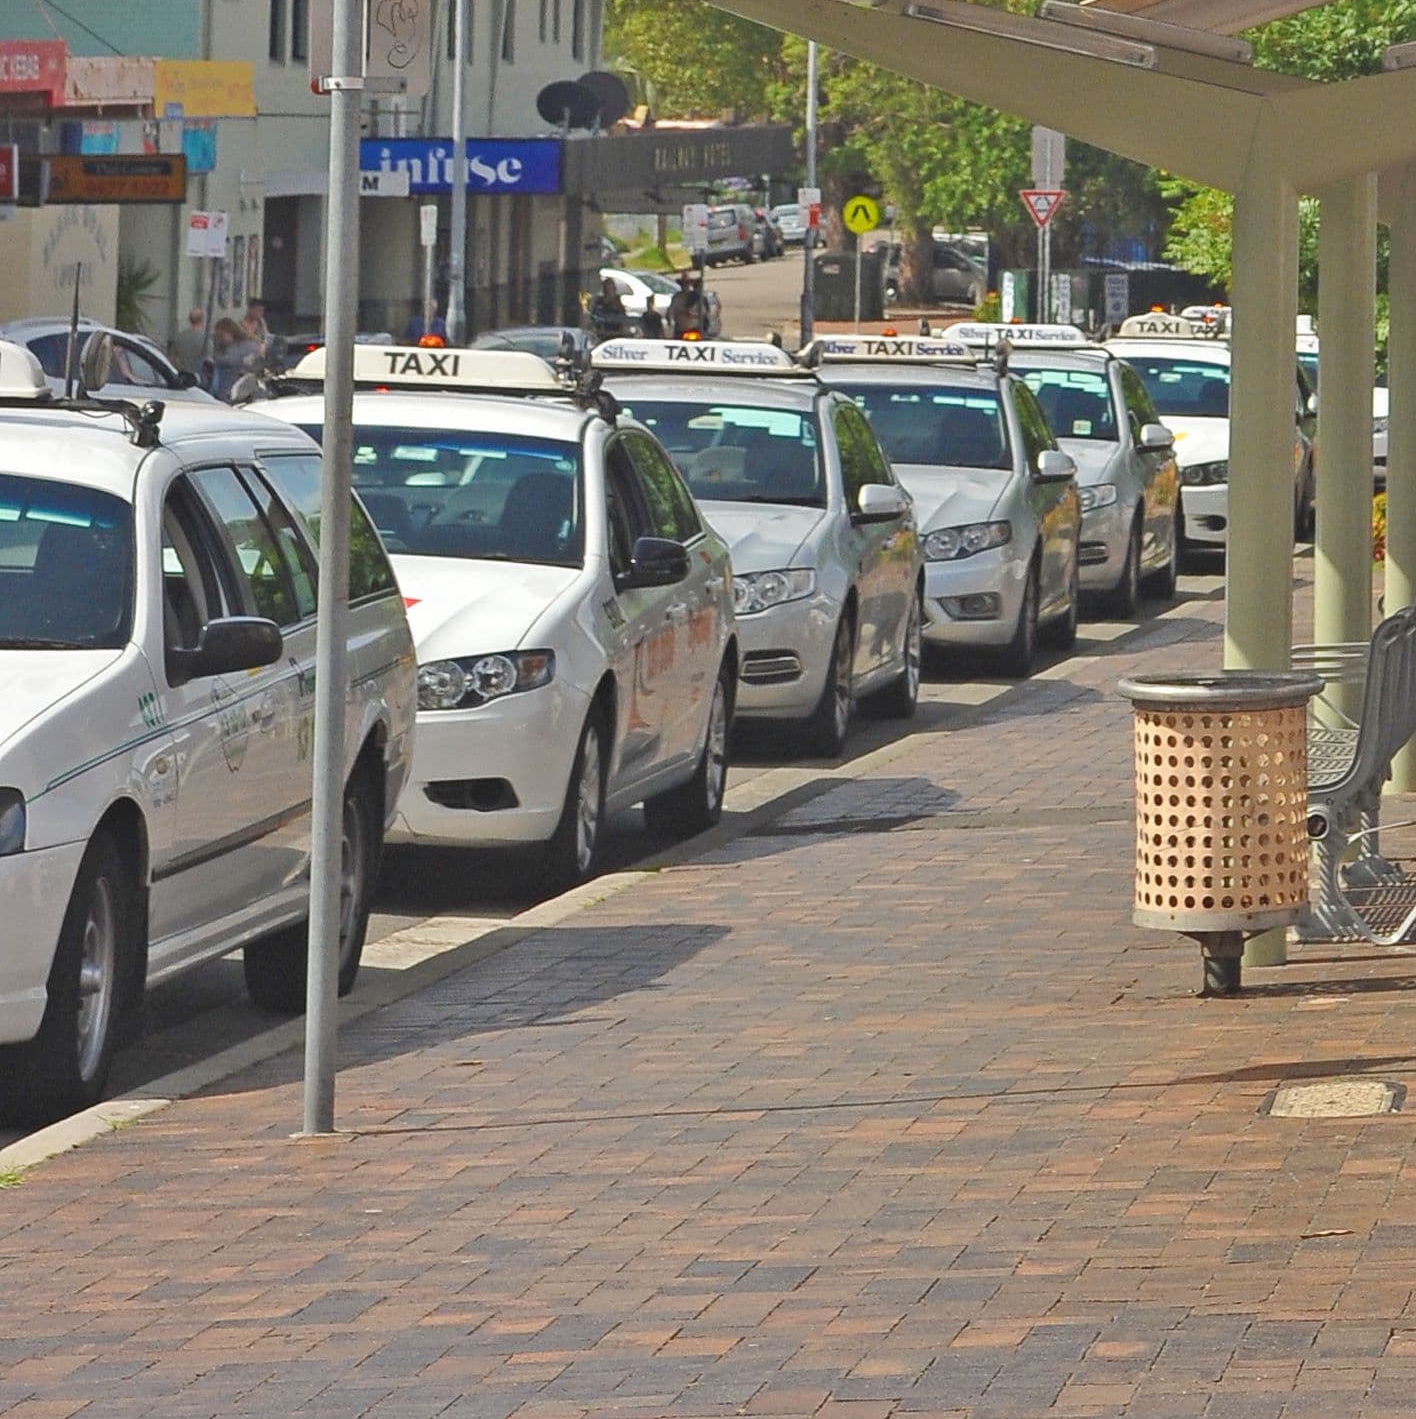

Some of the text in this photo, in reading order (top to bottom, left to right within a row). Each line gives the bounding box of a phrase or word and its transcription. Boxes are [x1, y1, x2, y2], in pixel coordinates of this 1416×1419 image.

[995, 327, 1034, 341] TAXI
[1035, 328, 1077, 341] Service
[1136, 321, 1181, 334] TAXI
[601, 344, 778, 365] Silver TAXI Service
[863, 340, 913, 356] TAXI
[916, 343, 965, 357] Service
[384, 351, 460, 377] TAXI
